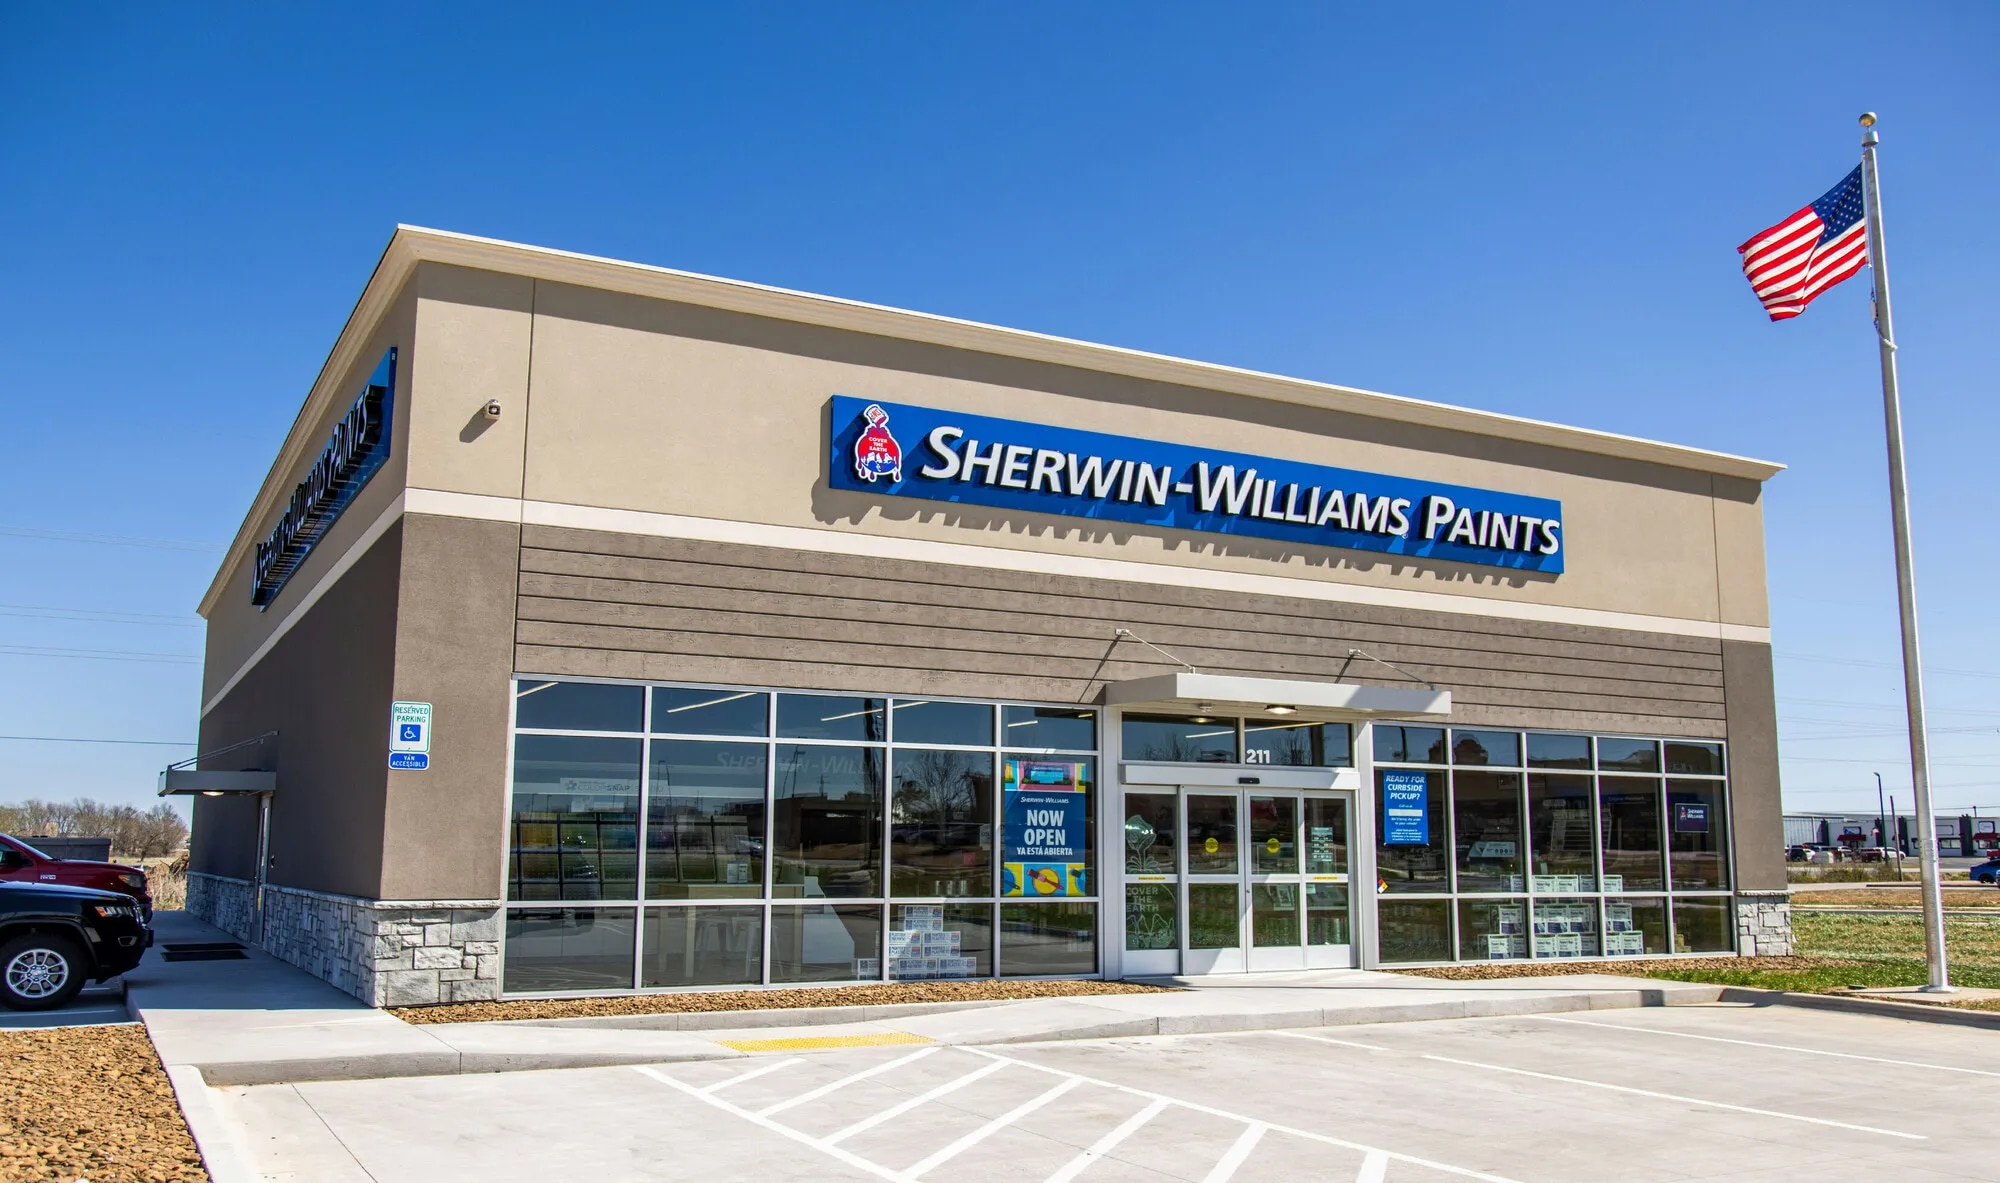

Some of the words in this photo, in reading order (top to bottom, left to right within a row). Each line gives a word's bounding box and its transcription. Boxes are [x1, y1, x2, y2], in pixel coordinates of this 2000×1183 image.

[921, 425, 1411, 536] SHERWIN-WILLIAMS
[1425, 495, 1561, 555] PAINTS
[394, 706, 429, 714] RESERVED
[396, 715, 426, 723] PARKING
[1246, 749, 1270, 764] 211
[392, 760, 425, 768] ACCESSIBLE
[1386, 775, 1409, 783] READY
[1411, 776, 1425, 784] FOR
[1387, 784, 1423, 792] CURBSIDE
[1390, 792, 1420, 800] PICKUP?
[1027, 810, 1064, 827] NOW
[1024, 829, 1066, 846] OPEN
[1017, 847, 1026, 855] YA
[1026, 846, 1043, 855] ESTÁ
[1044, 847, 1073, 856] ABIERTA
[1126, 887, 1158, 895] COVER
[1127, 904, 1159, 912] EARTH
